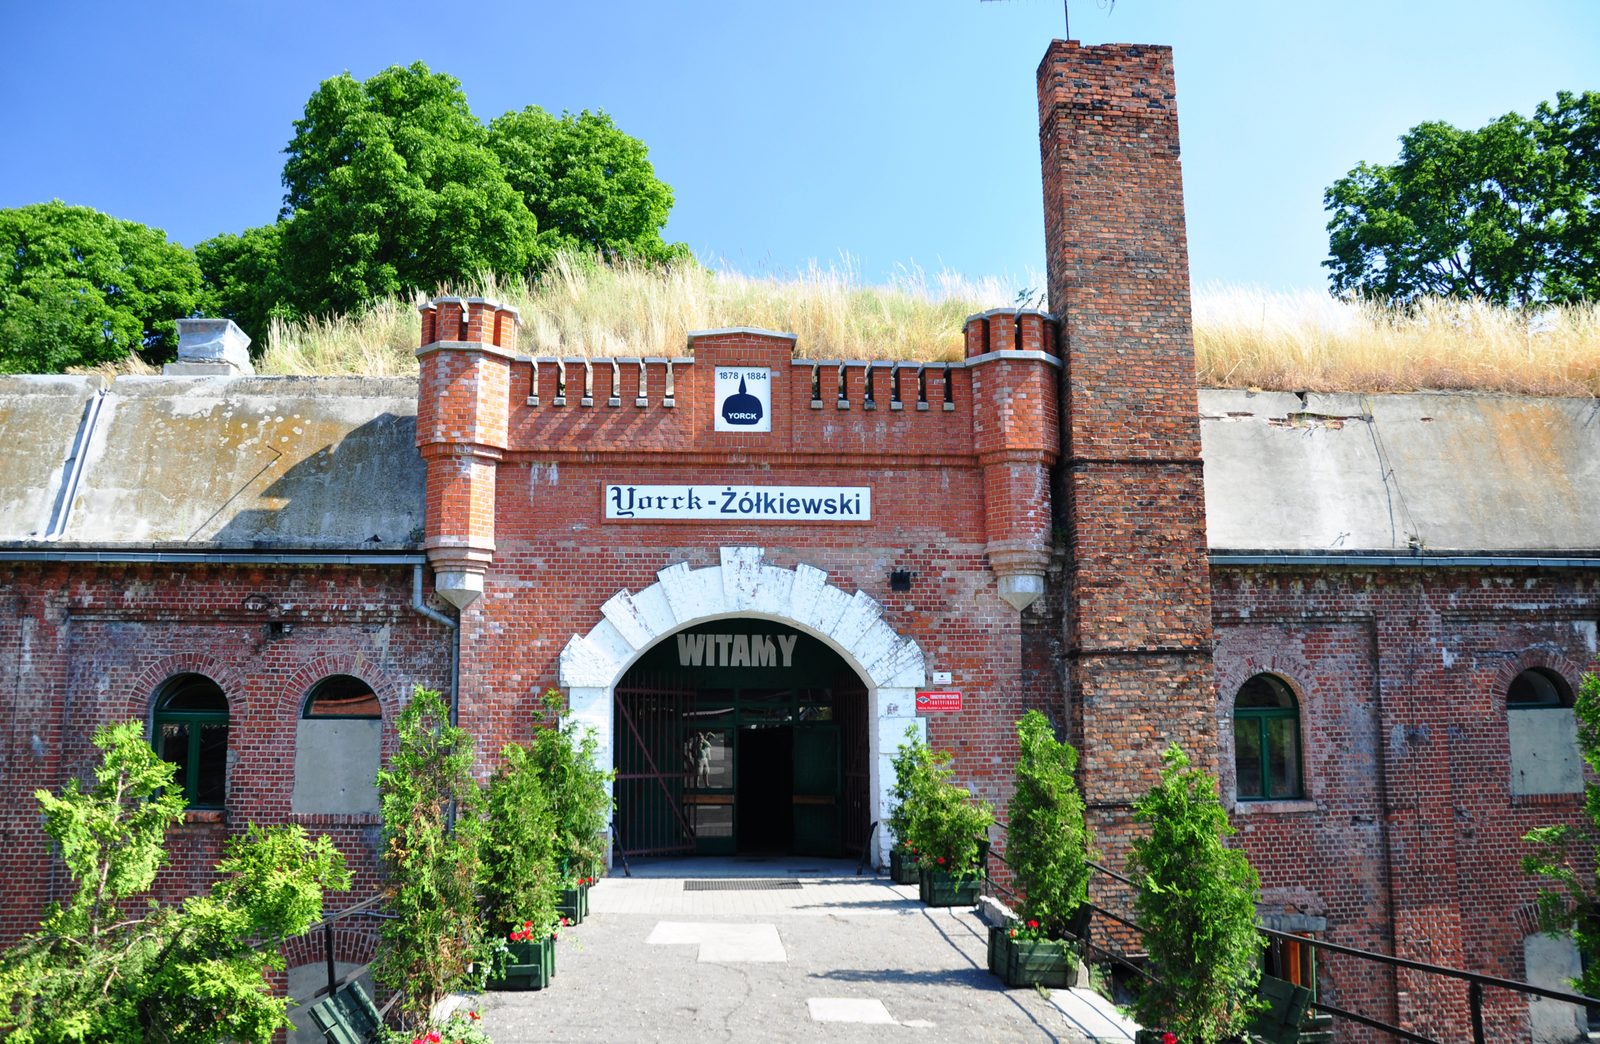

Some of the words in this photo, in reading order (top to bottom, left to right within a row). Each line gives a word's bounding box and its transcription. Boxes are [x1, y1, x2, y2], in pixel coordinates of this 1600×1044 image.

[719, 371, 739, 380] 1878
[746, 372, 767, 380] 1884
[728, 412, 757, 420] YORCK
[677, 633, 798, 667] WITAMY
